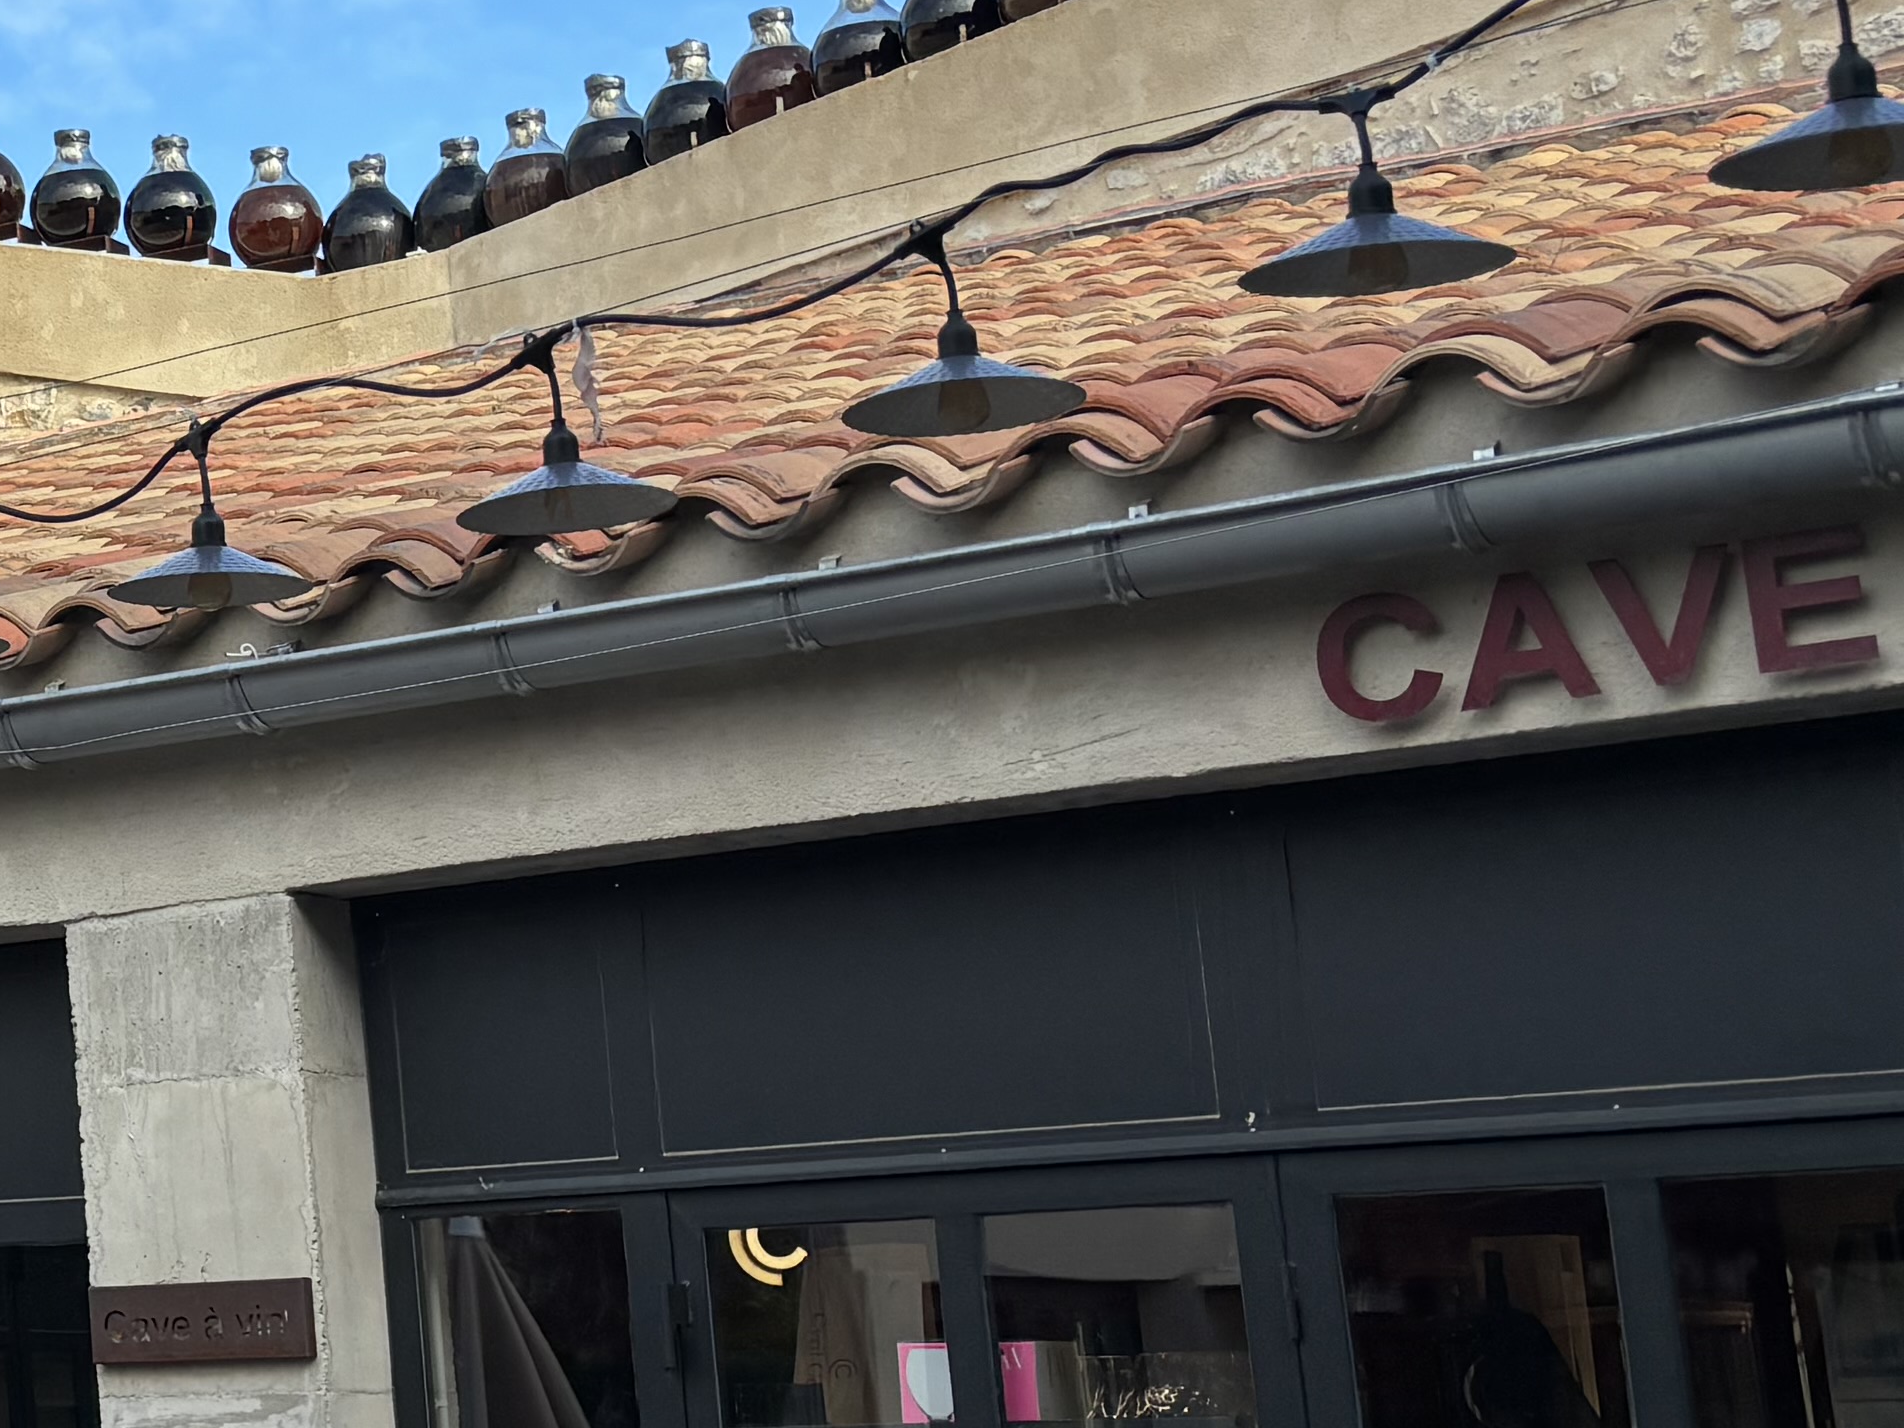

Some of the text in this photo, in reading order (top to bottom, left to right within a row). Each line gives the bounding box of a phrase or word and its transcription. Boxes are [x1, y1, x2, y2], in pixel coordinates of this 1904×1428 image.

[1317, 525, 1880, 722] CAVE
[104, 1304, 289, 1344] Cave à vin
